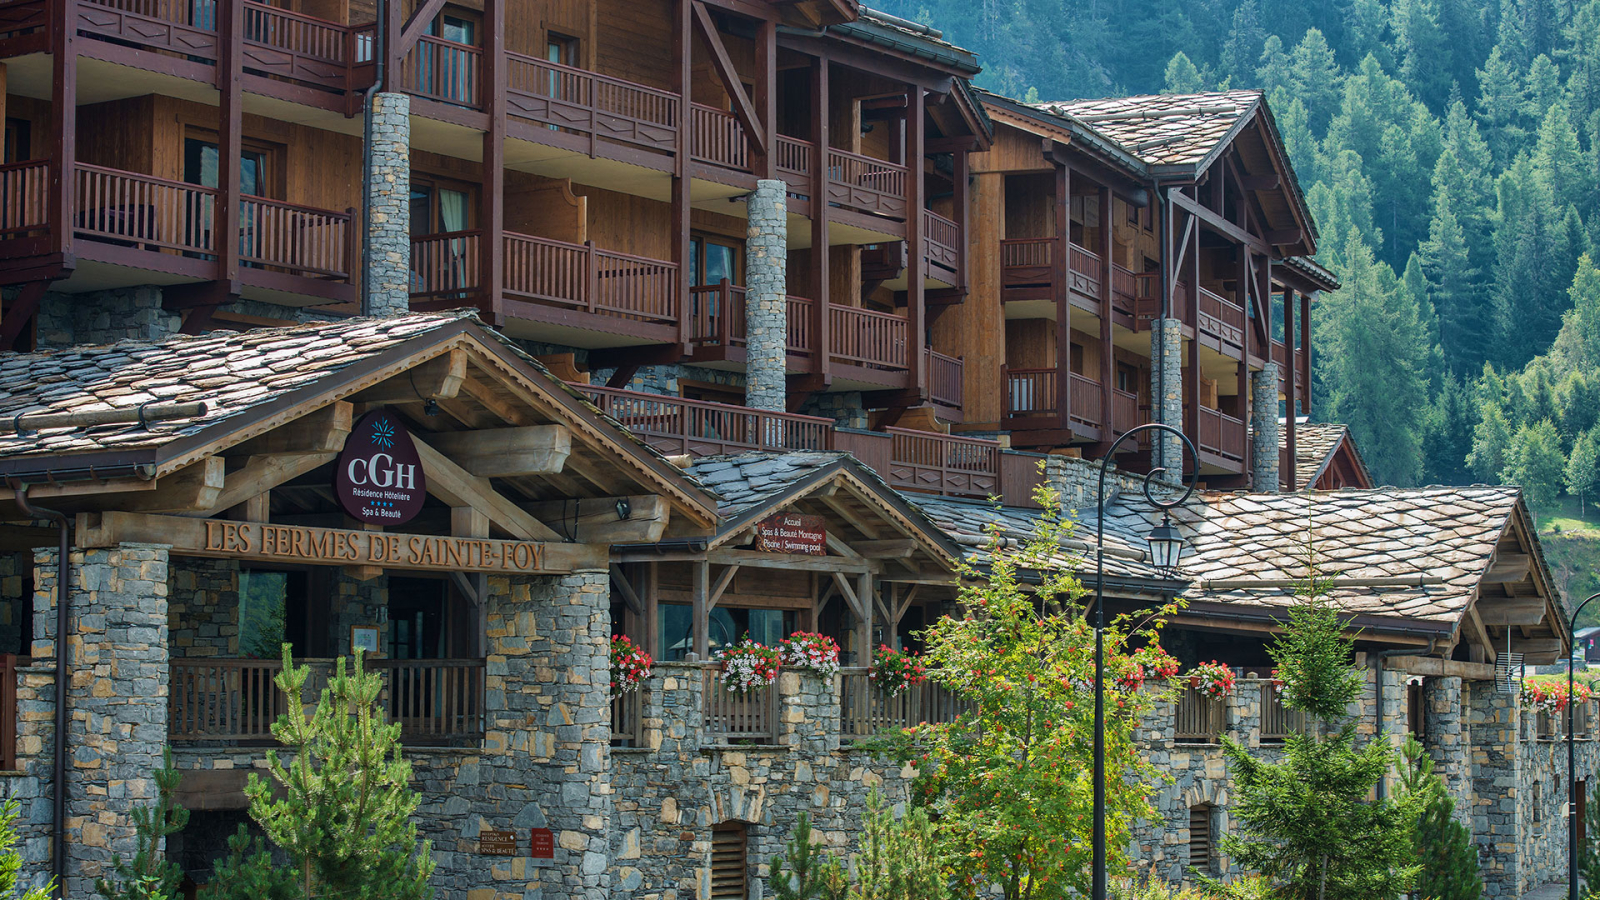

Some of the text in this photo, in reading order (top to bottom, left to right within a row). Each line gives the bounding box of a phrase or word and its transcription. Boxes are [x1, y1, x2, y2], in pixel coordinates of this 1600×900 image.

[347, 453, 416, 490] CGH
[353, 488, 410, 500] Résidence Hôtelière
[362, 507, 401, 518] Spa & Beauté
[784, 517, 801, 526] Accueil
[762, 527, 822, 541] Spas & Beauté Montagne
[205, 521, 546, 570] LES FERMES DE SAINTE-FOY
[764, 539, 780, 548] Piscine
[785, 540, 808, 552] Swimming
[810, 543, 820, 552] pool
